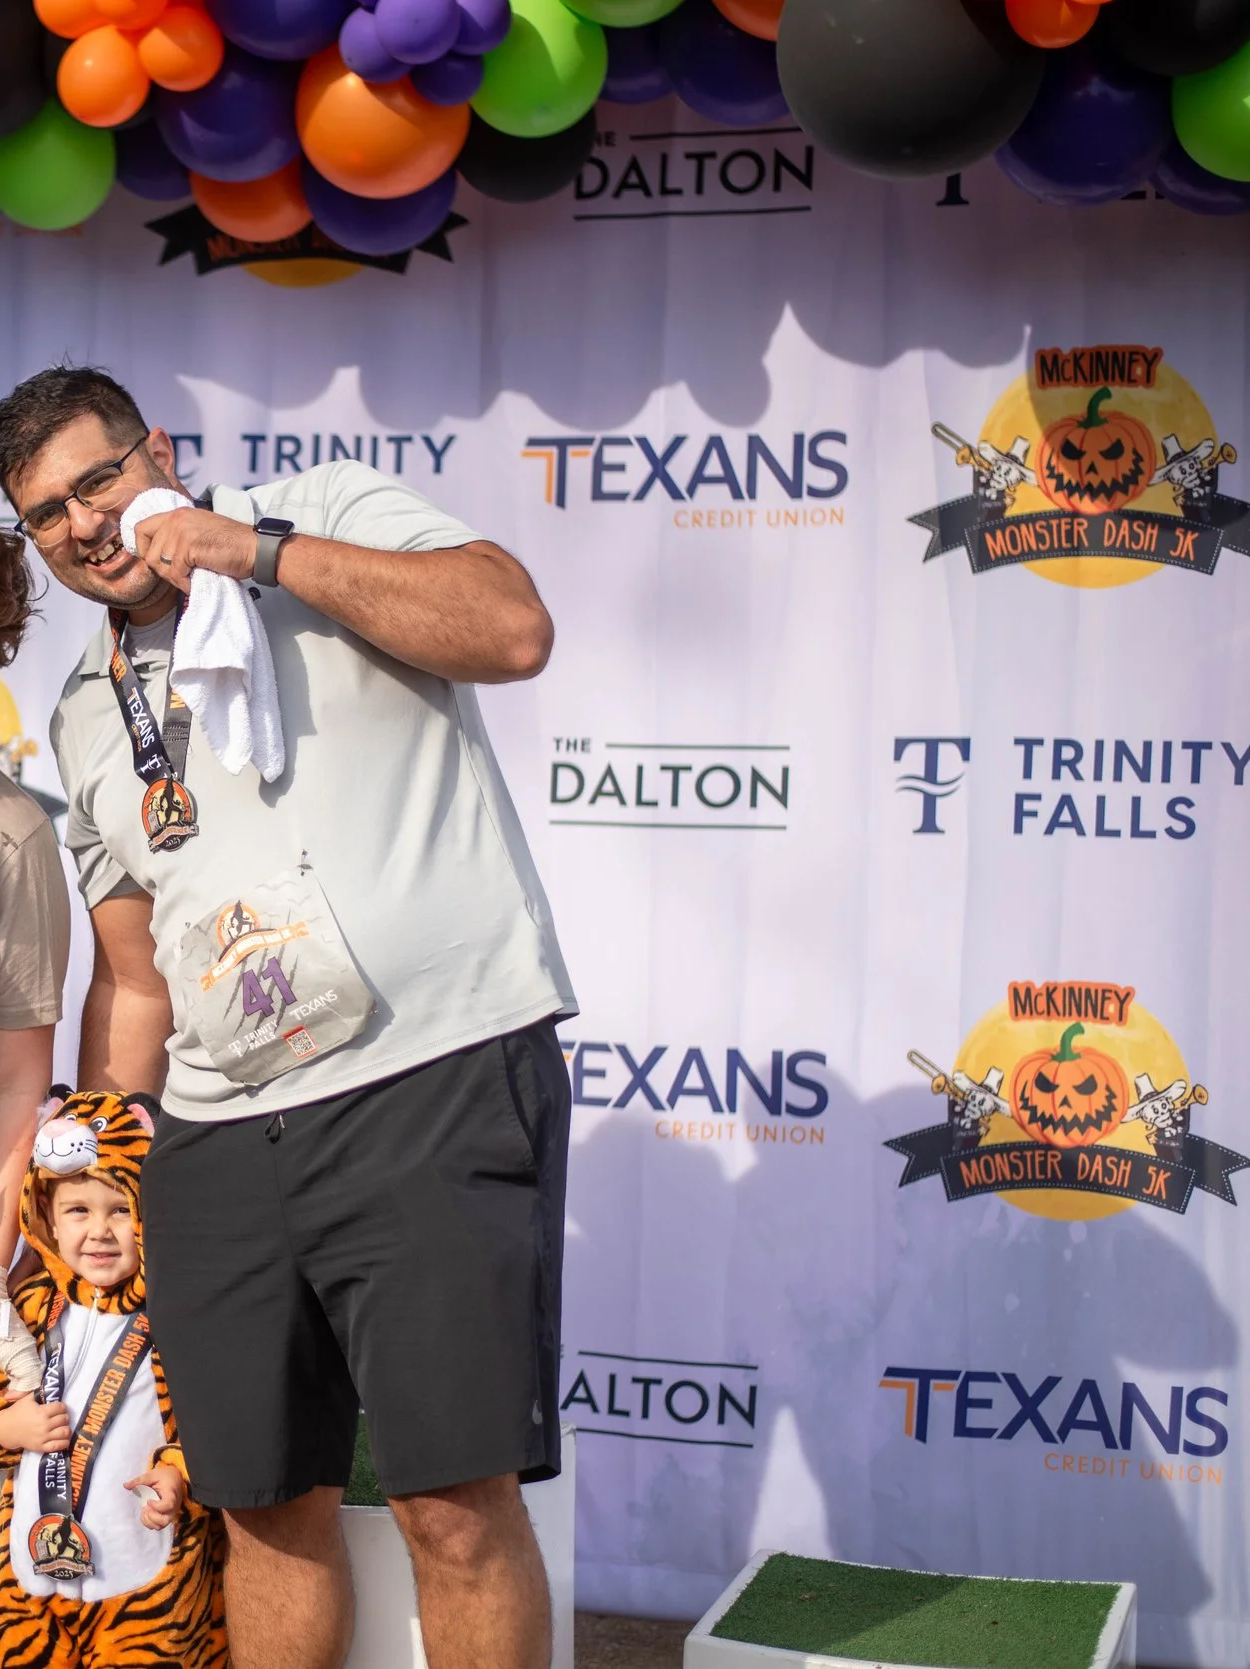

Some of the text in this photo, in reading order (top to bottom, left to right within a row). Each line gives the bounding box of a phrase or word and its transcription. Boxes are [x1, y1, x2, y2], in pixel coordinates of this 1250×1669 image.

[574, 145, 815, 200] DALTON
[1039, 350, 1160, 385] McKINNEY
[241, 434, 457, 474] TRINITY
[521, 430, 848, 510] TEXANS
[674, 506, 845, 529] CREDIT UNION
[984, 517, 1199, 561] MONSTER DASH 5K
[127, 687, 155, 748] TEXANS
[553, 737, 591, 753] THE
[1013, 737, 1250, 786] TRINITY
[550, 761, 790, 810] DALTON
[1013, 792, 1196, 840] FALLS
[242, 956, 298, 1018] 41
[289, 989, 338, 1021] TEXANS
[1012, 985, 1131, 1022] McKINNEY
[244, 1019, 278, 1043] TRINITY
[249, 1033, 276, 1051] FALLS
[559, 1040, 829, 1119] EXANS
[655, 1120, 826, 1145] CREDIT UNION
[959, 1150, 1171, 1199] MONSTER DASH 5K
[45, 1342, 61, 1404] TEXAN
[83, 1368, 126, 1436] MONSTER
[113, 1333, 146, 1369] DASH
[560, 1368, 758, 1429] ALTON
[879, 1366, 1229, 1457] TEXANS
[45, 1452, 58, 1489] FALLS
[57, 1451, 67, 1500] TRINITY
[1044, 1452, 1224, 1486] CREDIT UNION
